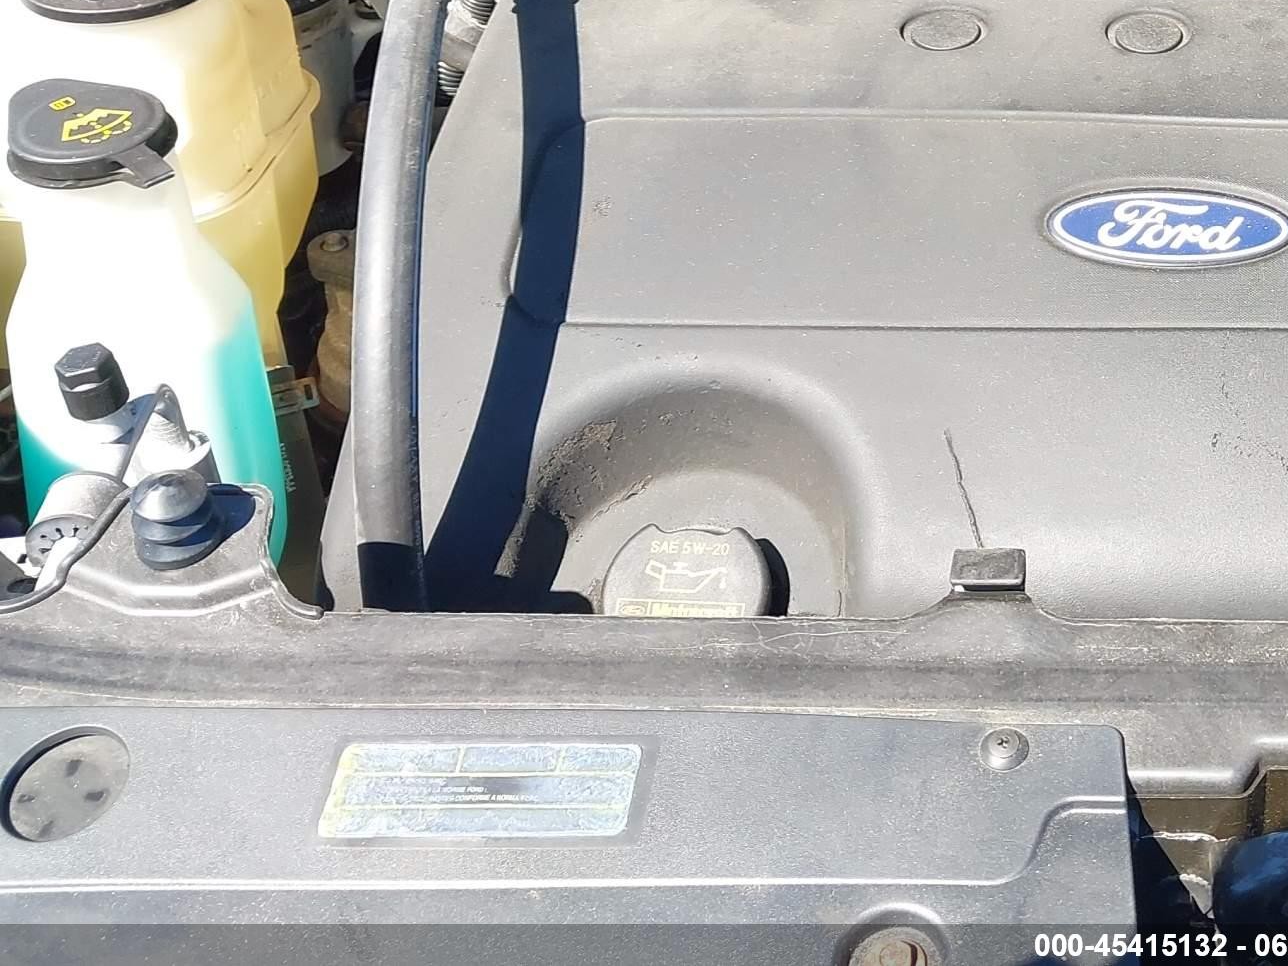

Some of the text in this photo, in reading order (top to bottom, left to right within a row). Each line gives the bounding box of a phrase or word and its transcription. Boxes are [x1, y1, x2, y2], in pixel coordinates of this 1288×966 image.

[1097, 199, 1245, 252] Ford
[650, 540, 730, 556] SAE 5W-20
